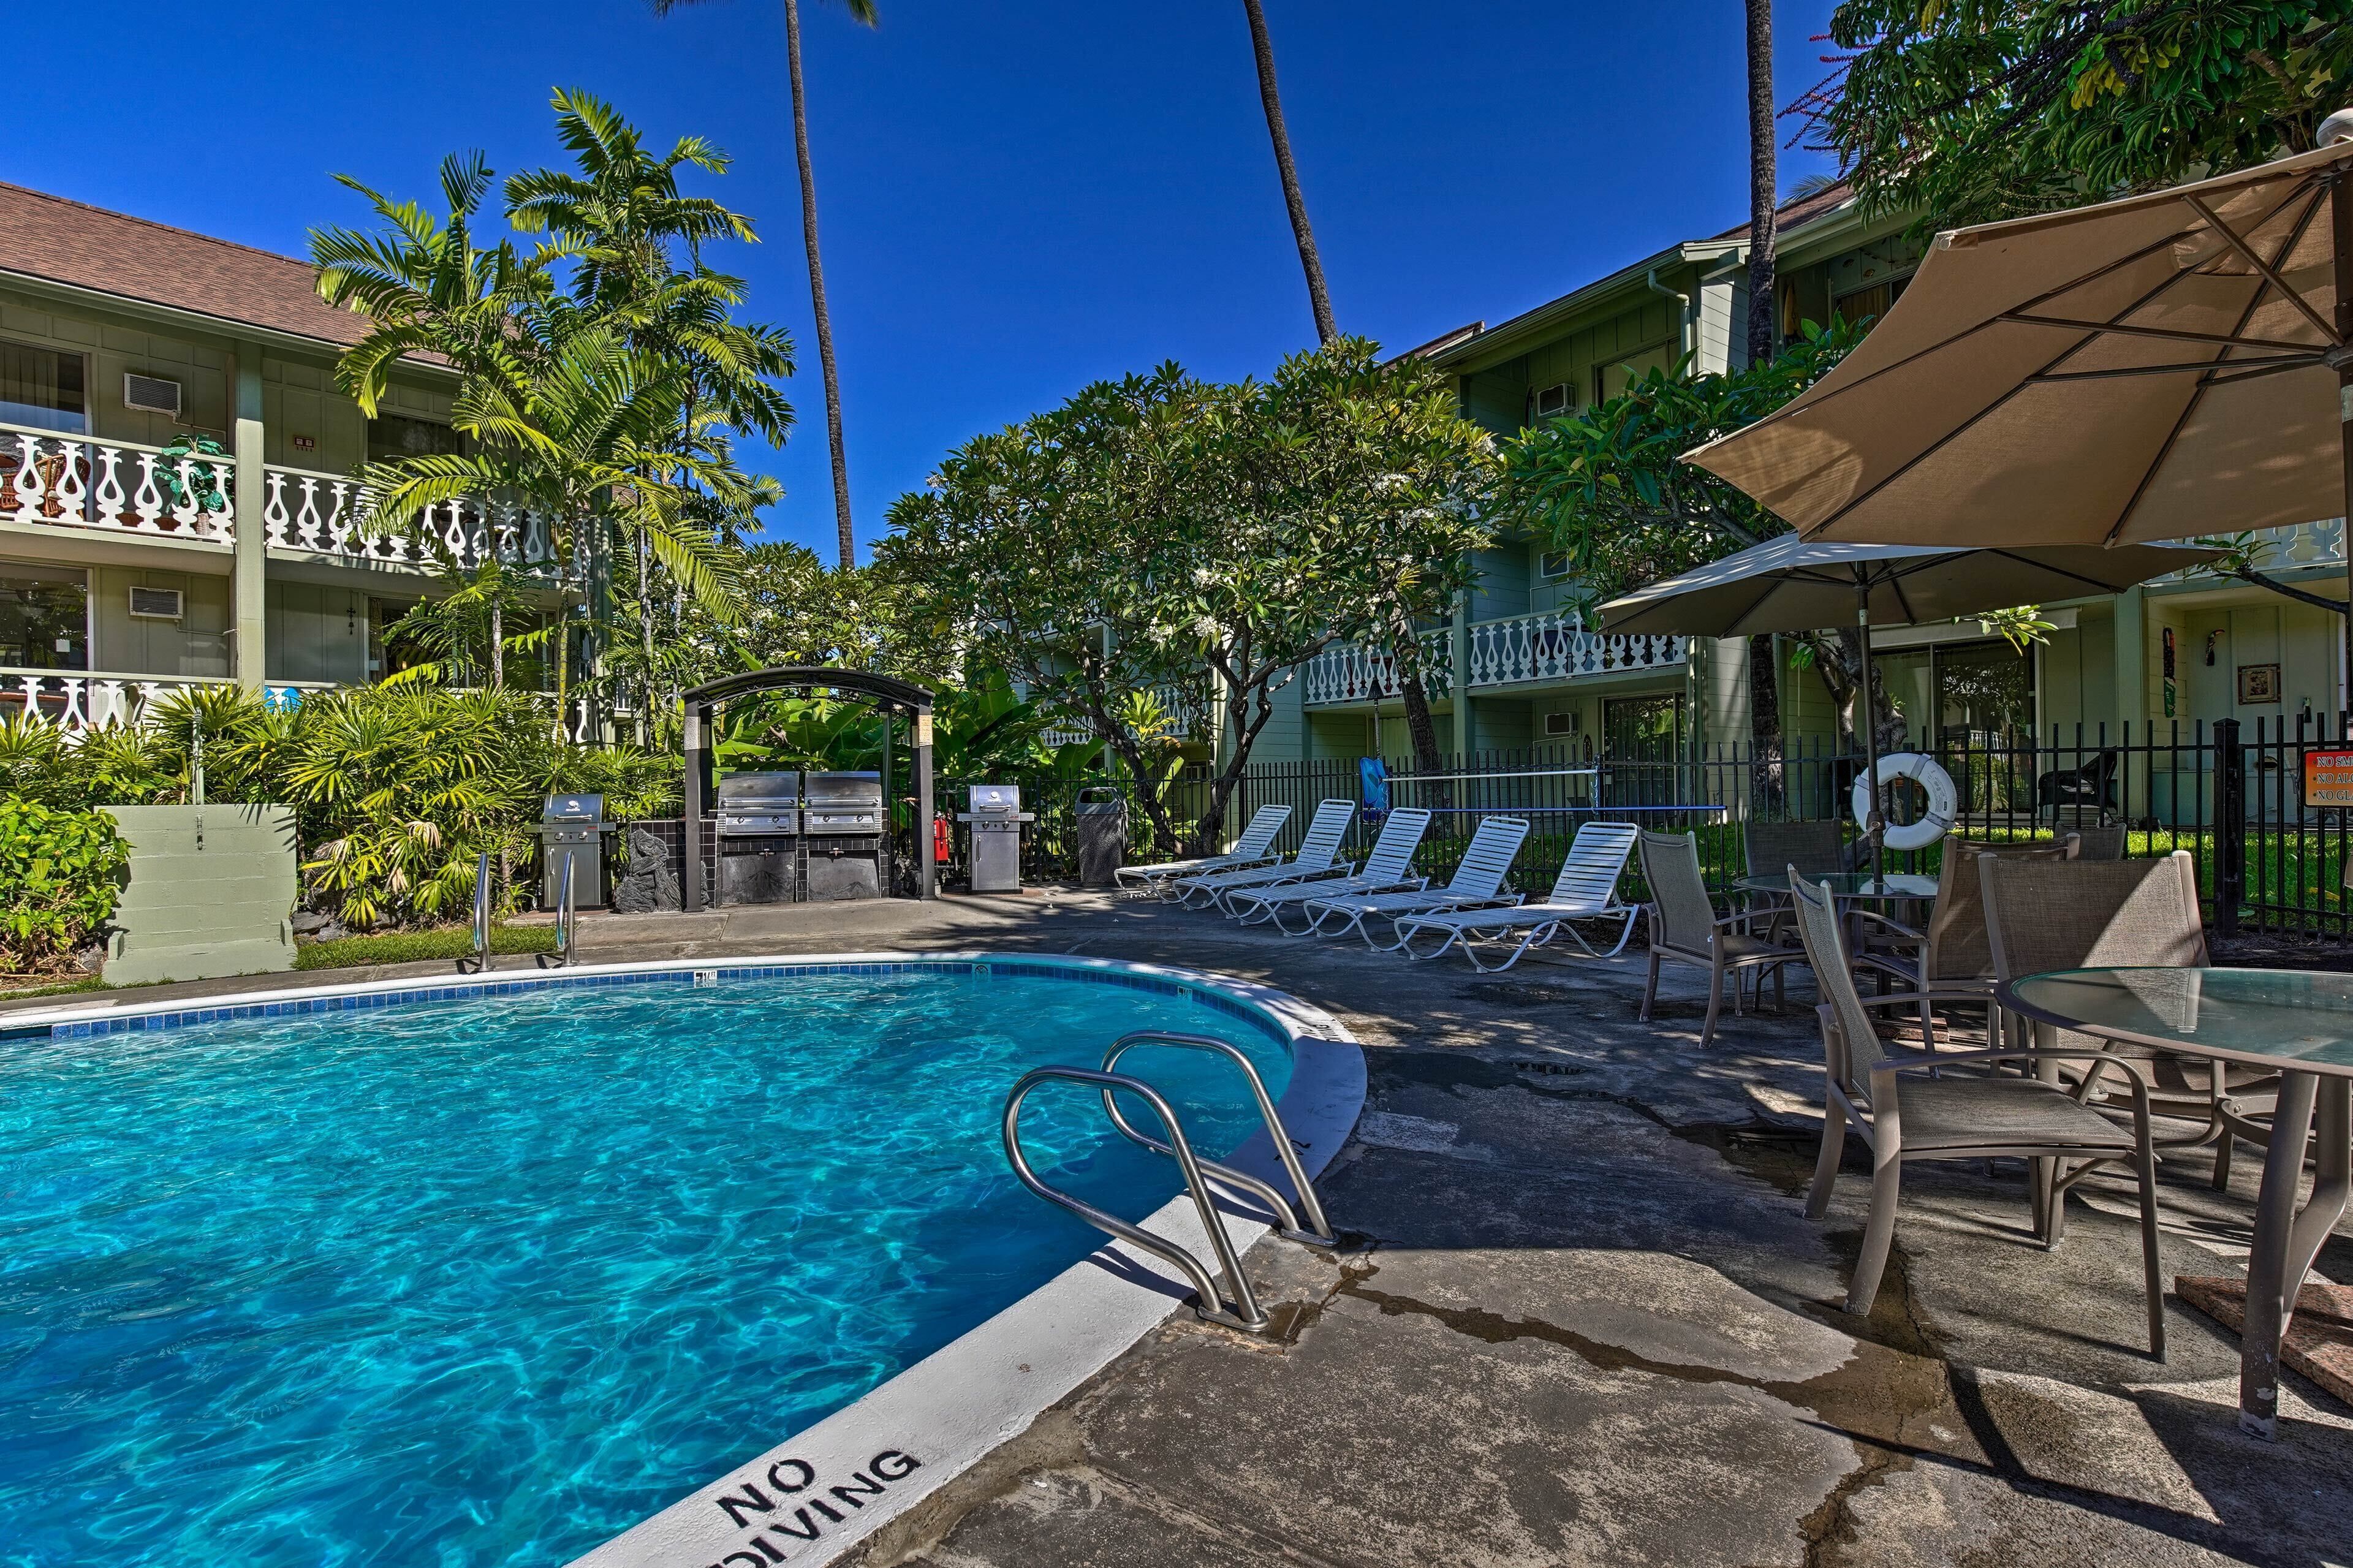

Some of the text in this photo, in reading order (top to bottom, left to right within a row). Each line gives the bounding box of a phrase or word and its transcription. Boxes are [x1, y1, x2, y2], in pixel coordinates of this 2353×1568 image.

[2317, 756, 2353, 768] NO SM
[2317, 773, 2334, 784] NO
[2317, 789, 2334, 801] NO
[716, 1458, 815, 1528] NO
